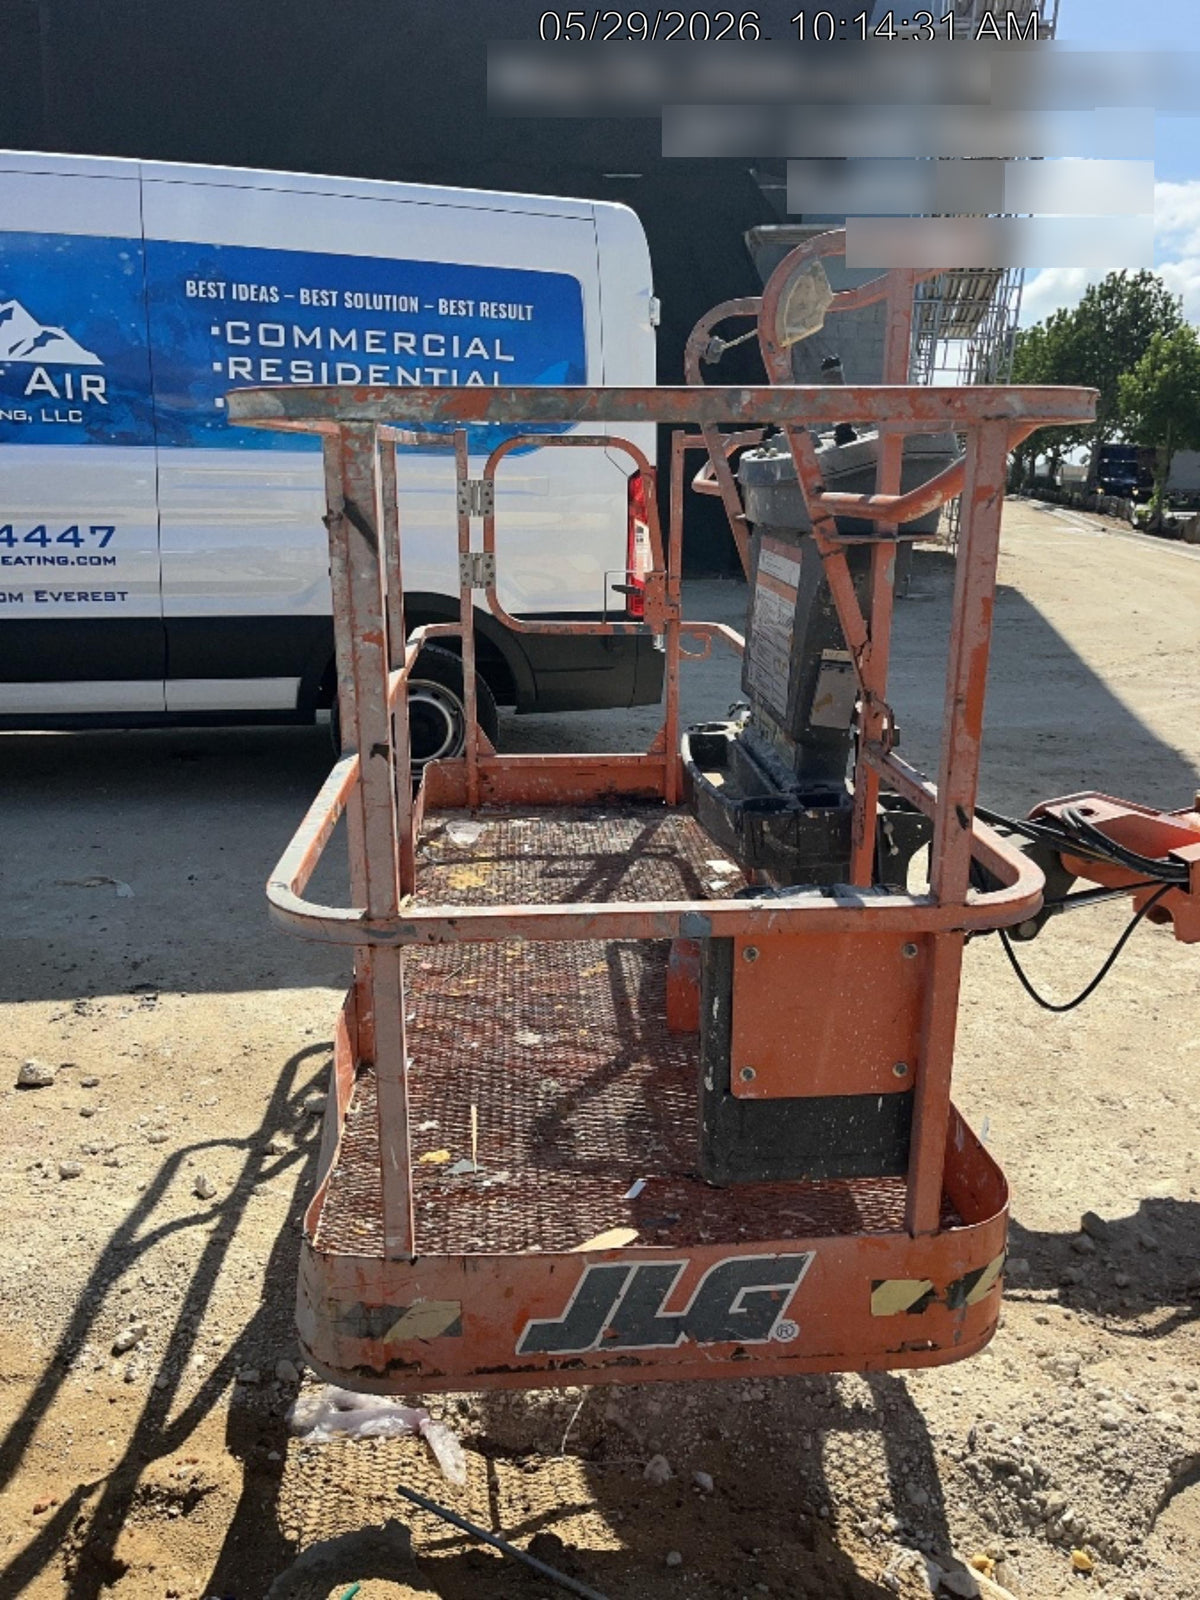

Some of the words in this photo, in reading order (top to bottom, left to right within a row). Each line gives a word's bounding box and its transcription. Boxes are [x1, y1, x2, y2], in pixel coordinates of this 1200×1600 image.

[186, 280, 226, 299] BEST
[232, 283, 280, 303] IDEAS
[300, 288, 338, 307] BEST
[344, 291, 419, 313] SOLUTION
[438, 298, 475, 317] BEST
[479, 302, 534, 321] RESULT
[226, 321, 515, 362] COMMERCIAL
[24, 366, 109, 405] AIR
[41, 408, 83, 422] LLC
[1, 556, 116, 566] EATING.COM
